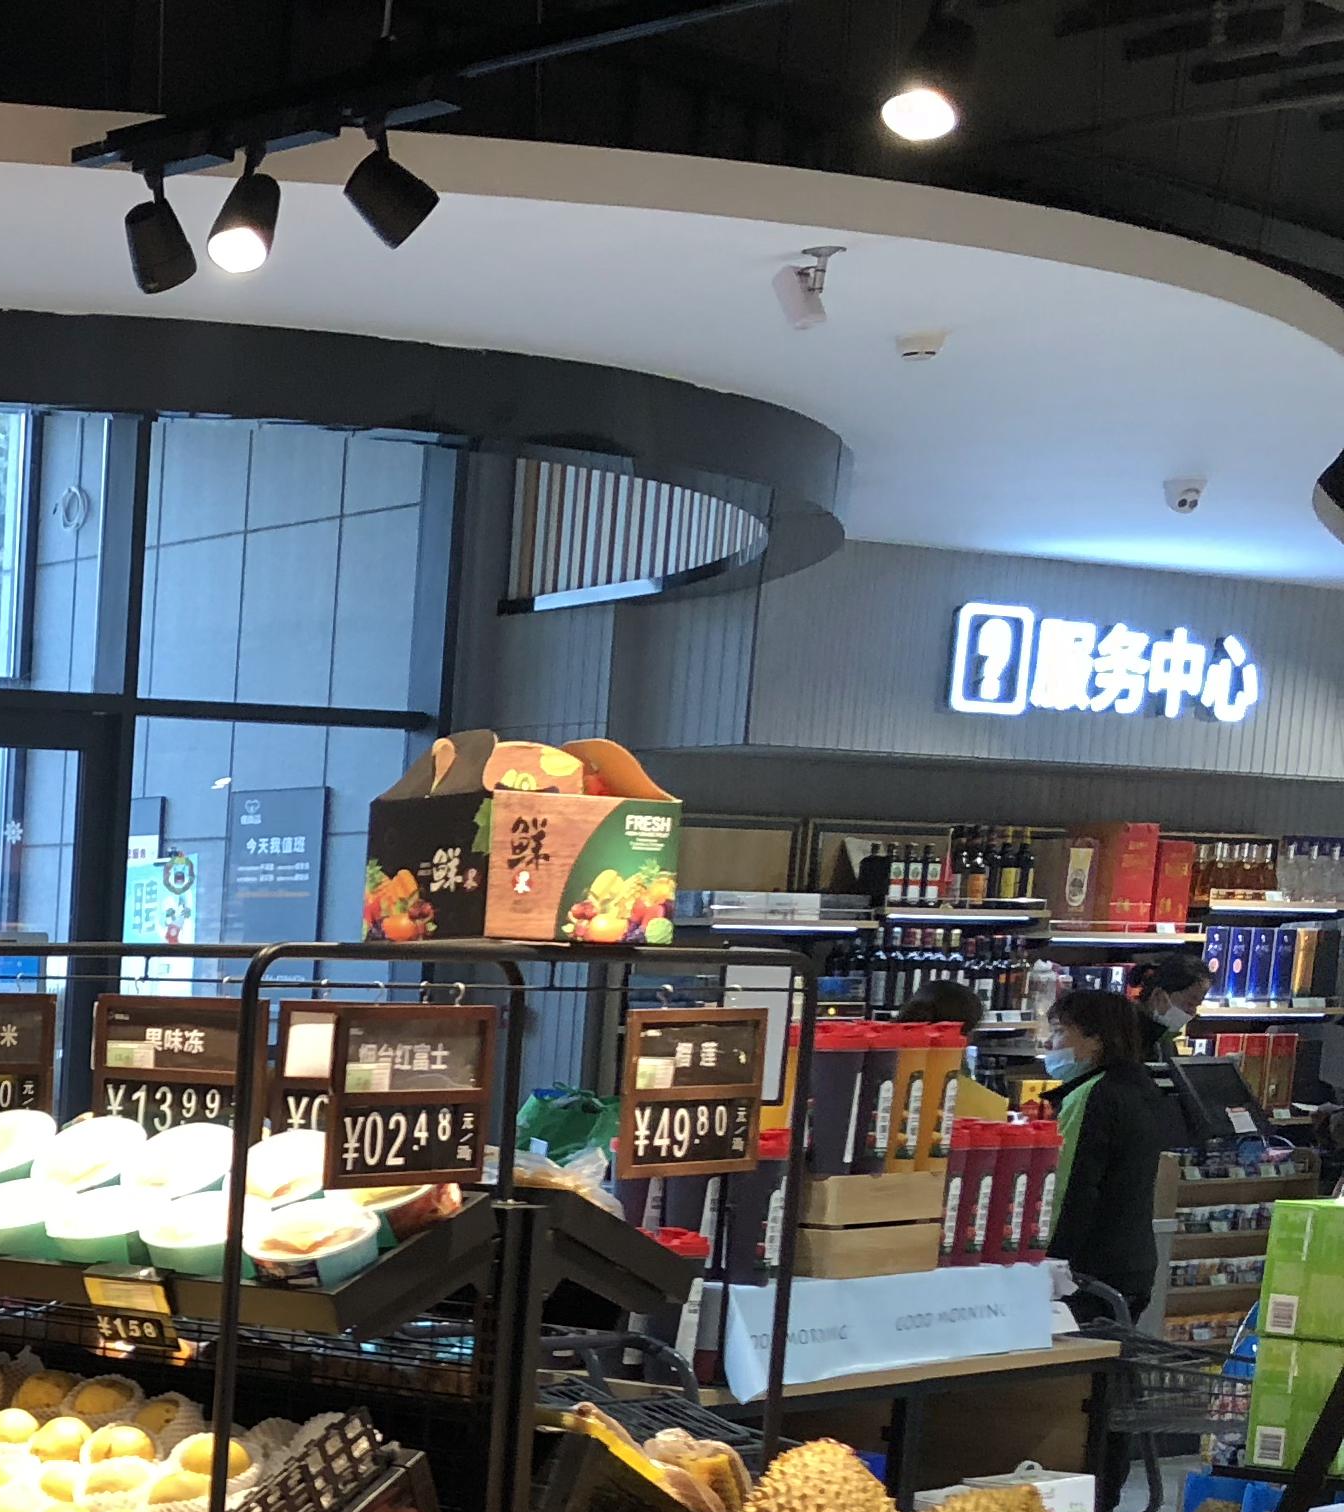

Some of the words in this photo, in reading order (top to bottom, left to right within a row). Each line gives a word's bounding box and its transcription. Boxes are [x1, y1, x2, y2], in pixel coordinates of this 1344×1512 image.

[1030, 618, 1258, 723] 服务中心
[625, 814, 672, 832] FRESH
[145, 1027, 206, 1054] 果味冻
[634, 1105, 728, 1158] ¥49.80
